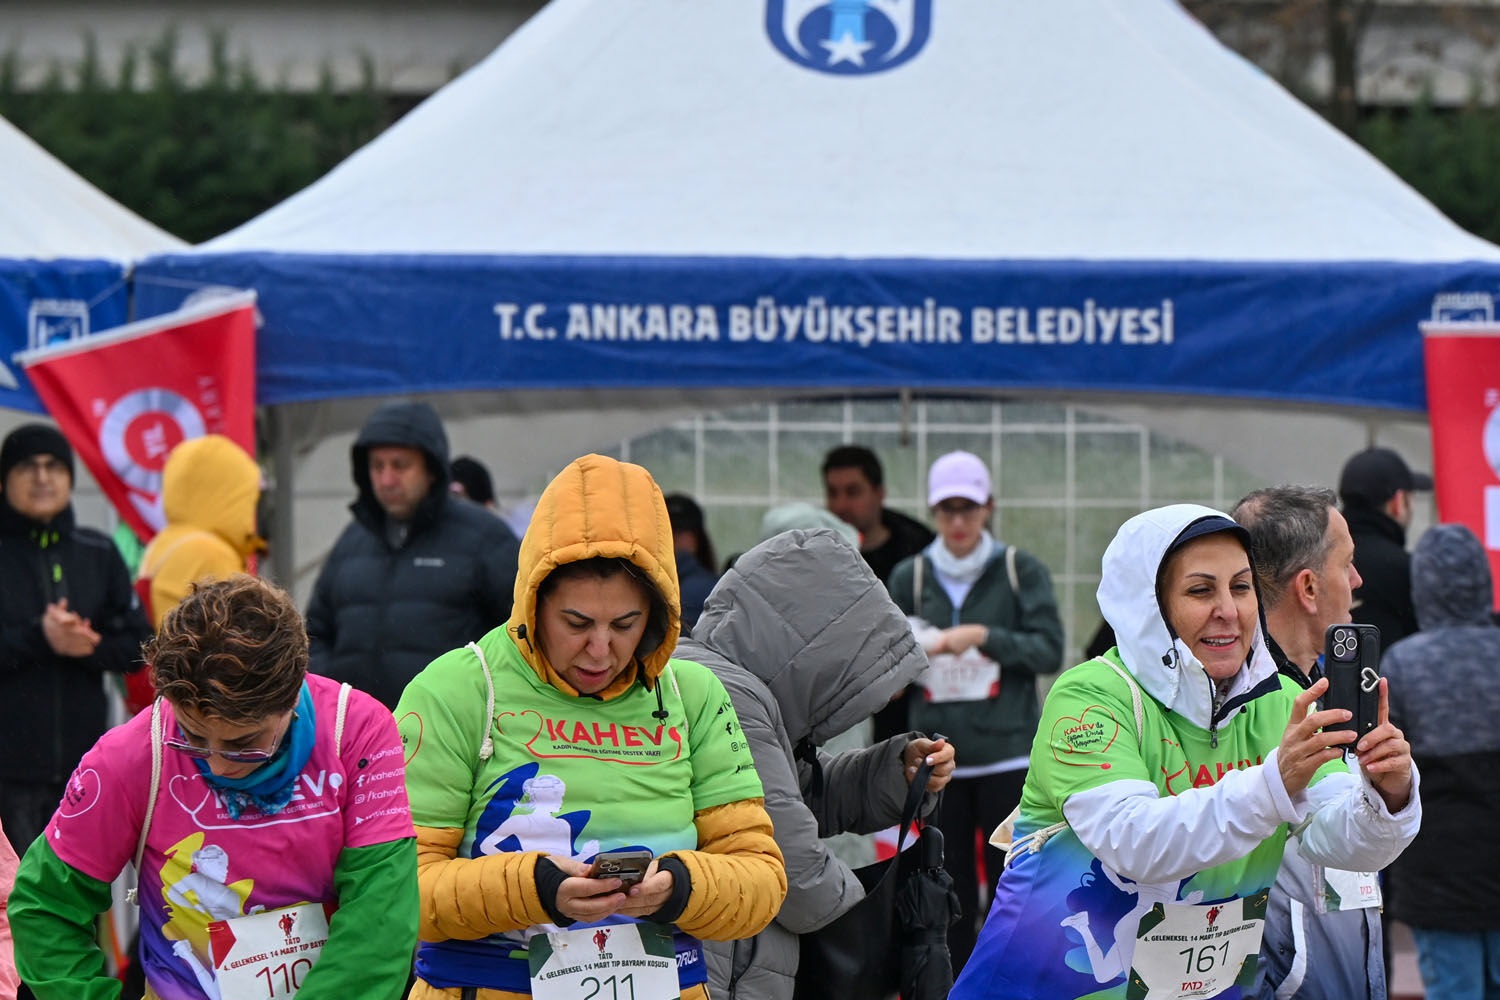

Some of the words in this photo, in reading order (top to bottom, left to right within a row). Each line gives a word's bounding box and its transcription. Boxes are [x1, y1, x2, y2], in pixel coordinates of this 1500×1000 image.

[494, 304, 556, 341] T.C.
[565, 303, 720, 342] ANKARA
[728, 297, 963, 348] BÜYÜKŞEHİR
[971, 298, 1175, 345] BELEDİYESİ
[545, 718, 664, 747] KAHEV
[1063, 723, 1095, 737] KAHEV
[1206, 925, 1219, 933] TATD
[284, 936, 301, 946] TATD
[1199, 933, 1214, 941] MART
[230, 952, 269, 970] GELENEKSEL
[270, 951, 279, 960] 14
[280, 946, 299, 957] MART
[299, 944, 309, 953] TIP
[598, 952, 613, 961] TATD
[1179, 940, 1230, 974] 161
[546, 966, 583, 979] GELENEKSEL
[584, 963, 592, 971] 14
[593, 961, 610, 970] MART
[611, 960, 621, 968] TIP
[621, 960, 646, 968] BAYRAMI
[647, 960, 669, 969] KOŞUSU
[1181, 980, 1203, 992] TATD
